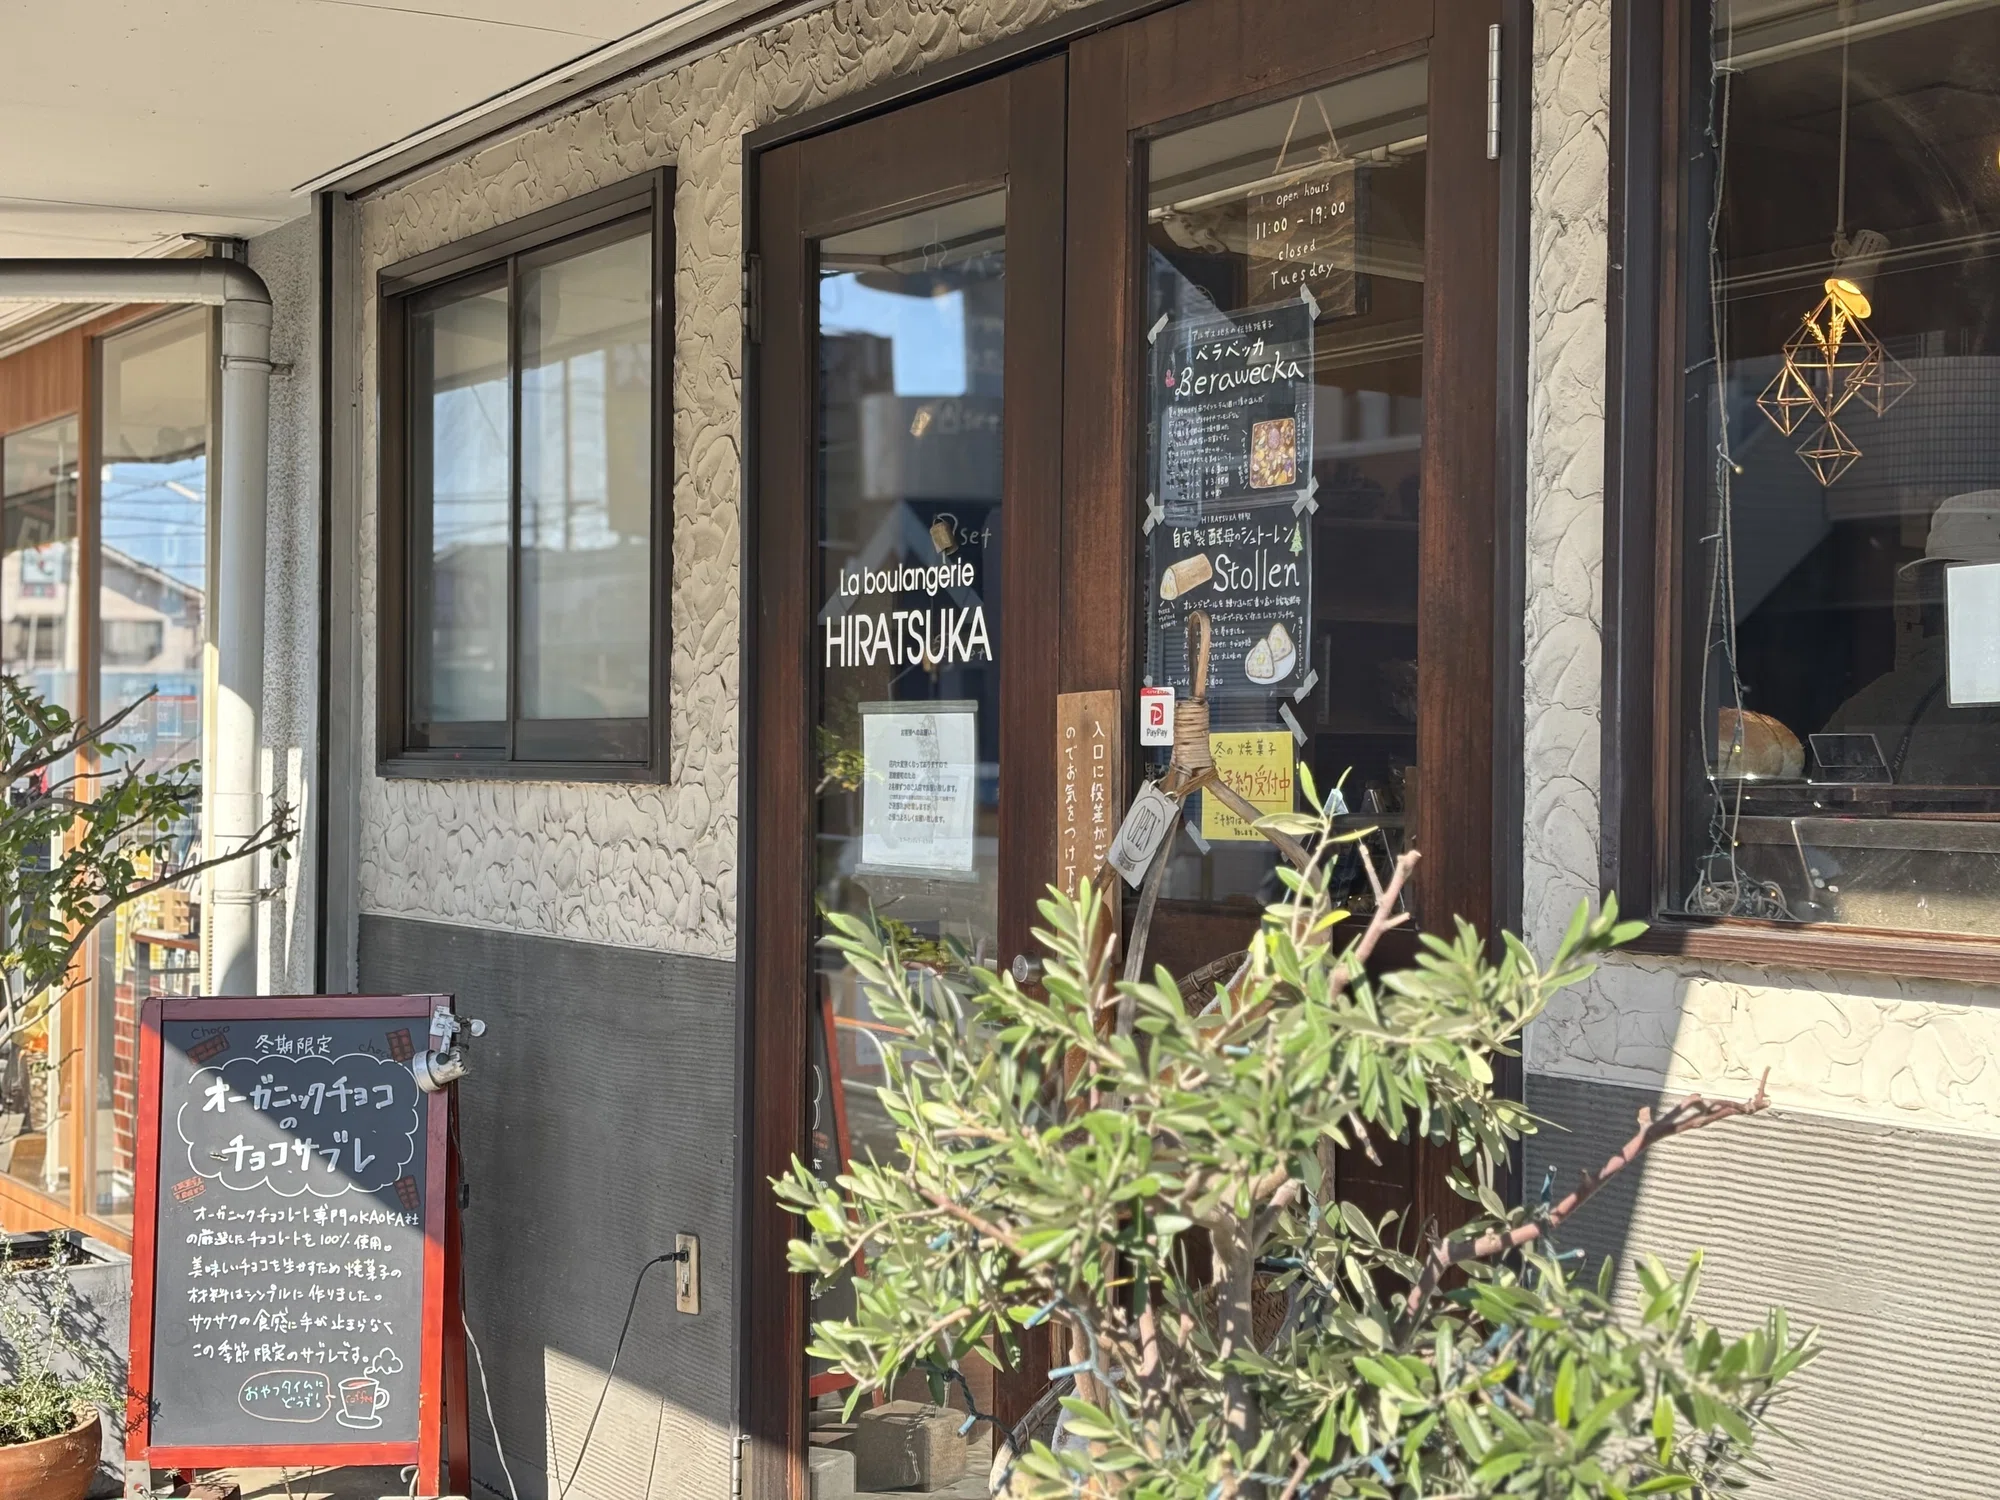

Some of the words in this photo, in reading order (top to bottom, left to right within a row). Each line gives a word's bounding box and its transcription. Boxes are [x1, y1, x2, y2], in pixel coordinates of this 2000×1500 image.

[1304, 180, 1330, 198] hours
[1256, 216, 1288, 241] 11:00
[1310, 200, 1346, 226] 19:00
[1278, 238, 1316, 262] closed
[1271, 261, 1334, 291] Tuesday
[1196, 337, 1265, 361] ベラベッカ
[1175, 351, 1305, 397] Berawecka
[960, 527, 992, 549] set
[1172, 524, 1295, 549] 自家製酵母のシュトーレン
[840, 568, 859, 597] La
[864, 557, 975, 597] boulangerie
[1213, 548, 1300, 592] Stollen
[826, 605, 993, 668] HIRATSUKA
[1146, 728, 1168, 739] PayPay
[1214, 738, 1277, 758] 冬の焼菓子
[1126, 804, 1161, 853] OPEN
[190, 1025, 231, 1040] Choco
[255, 1034, 333, 1055] 冬期限定
[202, 1073, 395, 1115] オーガニックチョコ
[279, 1116, 298, 1130] の
[221, 1129, 376, 1173] チョコサブレ
[193, 1204, 419, 1227] オーガニックチョコレート専門のKAOKA社
[187, 1256, 403, 1282] 美味しいチョコを生かすため焼菓子の
[187, 1284, 383, 1304] 材料はシンプルに作りました。
[188, 1307, 394, 1335] サクサクの食感に手が止まらなく
[192, 1340, 370, 1364] この季節限定のサブレです。
[244, 1379, 324, 1402] おやつタイムに
